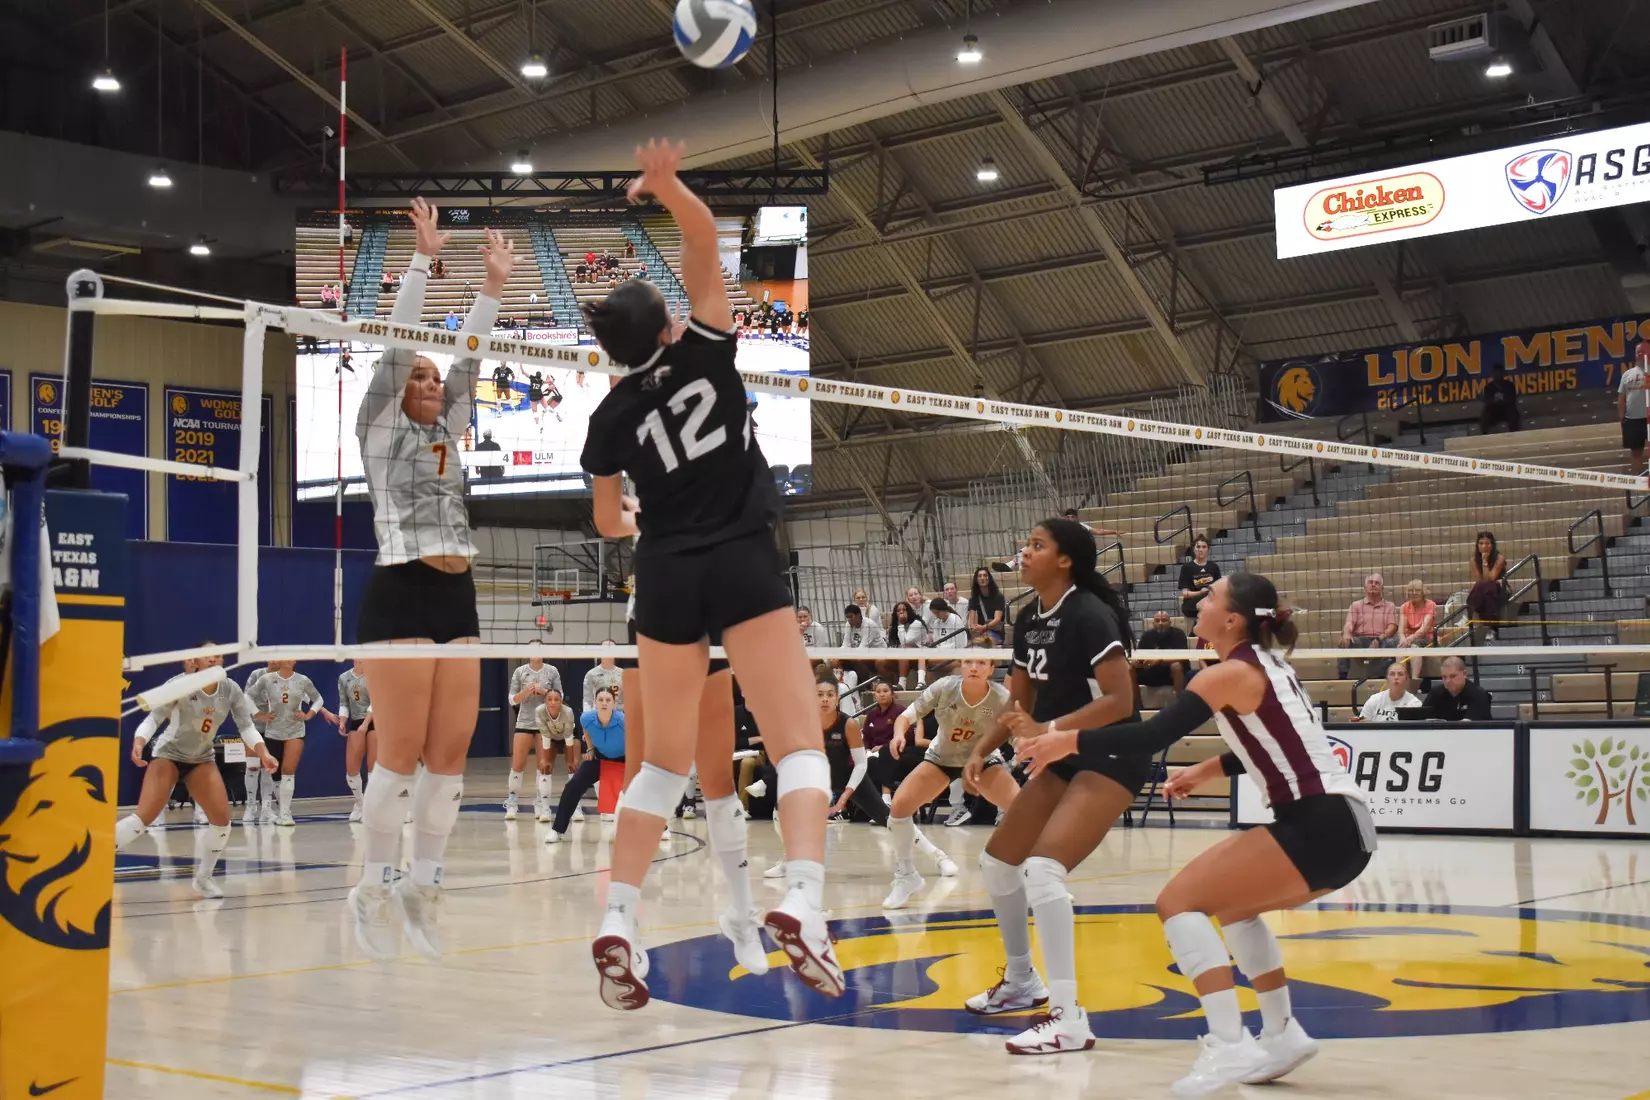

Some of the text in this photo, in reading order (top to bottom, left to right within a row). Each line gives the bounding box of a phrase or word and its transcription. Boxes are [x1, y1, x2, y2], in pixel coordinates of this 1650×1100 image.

[1575, 144, 1650, 186] ASG
[1323, 185, 1424, 215] Chicken
[1373, 206, 1427, 222] EXPRESS
[359, 323, 457, 345] EAST TEXAS A&M
[489, 341, 578, 361] EAST TEXAS A&M
[1364, 340, 1481, 386] LION
[742, 373, 791, 387] TEXAS A&M
[1438, 368, 1577, 403] CHAMNSHIPS
[89, 388, 124, 400] EN'S
[815, 382, 884, 400] EAST TEXAS A&M
[201, 399, 242, 410] WOME
[906, 394, 970, 410] EAST TEXAS A&M
[89, 412, 141, 421] HAMPIONSHIPS
[214, 409, 243, 419] GOL
[990, 405, 1049, 419] EAST TEXAS A&M
[1068, 413, 1085, 423] EAST
[1087, 416, 1107, 426] TEXAS
[173, 417, 200, 429] NCAA
[636, 378, 727, 473] 12
[1139, 423, 1155, 432] EAST
[1157, 425, 1176, 435] TEXAS
[175, 430, 215, 446] 2019
[175, 448, 215, 464] 2021
[432, 443, 447, 478] 7
[502, 452, 553, 462] 4 ULM
[58, 532, 94, 546] EAST
[53, 550, 97, 564] TEXAS
[52, 567, 100, 588] A&M
[1027, 648, 1048, 680] 22
[282, 692, 289, 703] 2
[201, 718, 212, 733] 6
[1355, 751, 1446, 792] ASG
